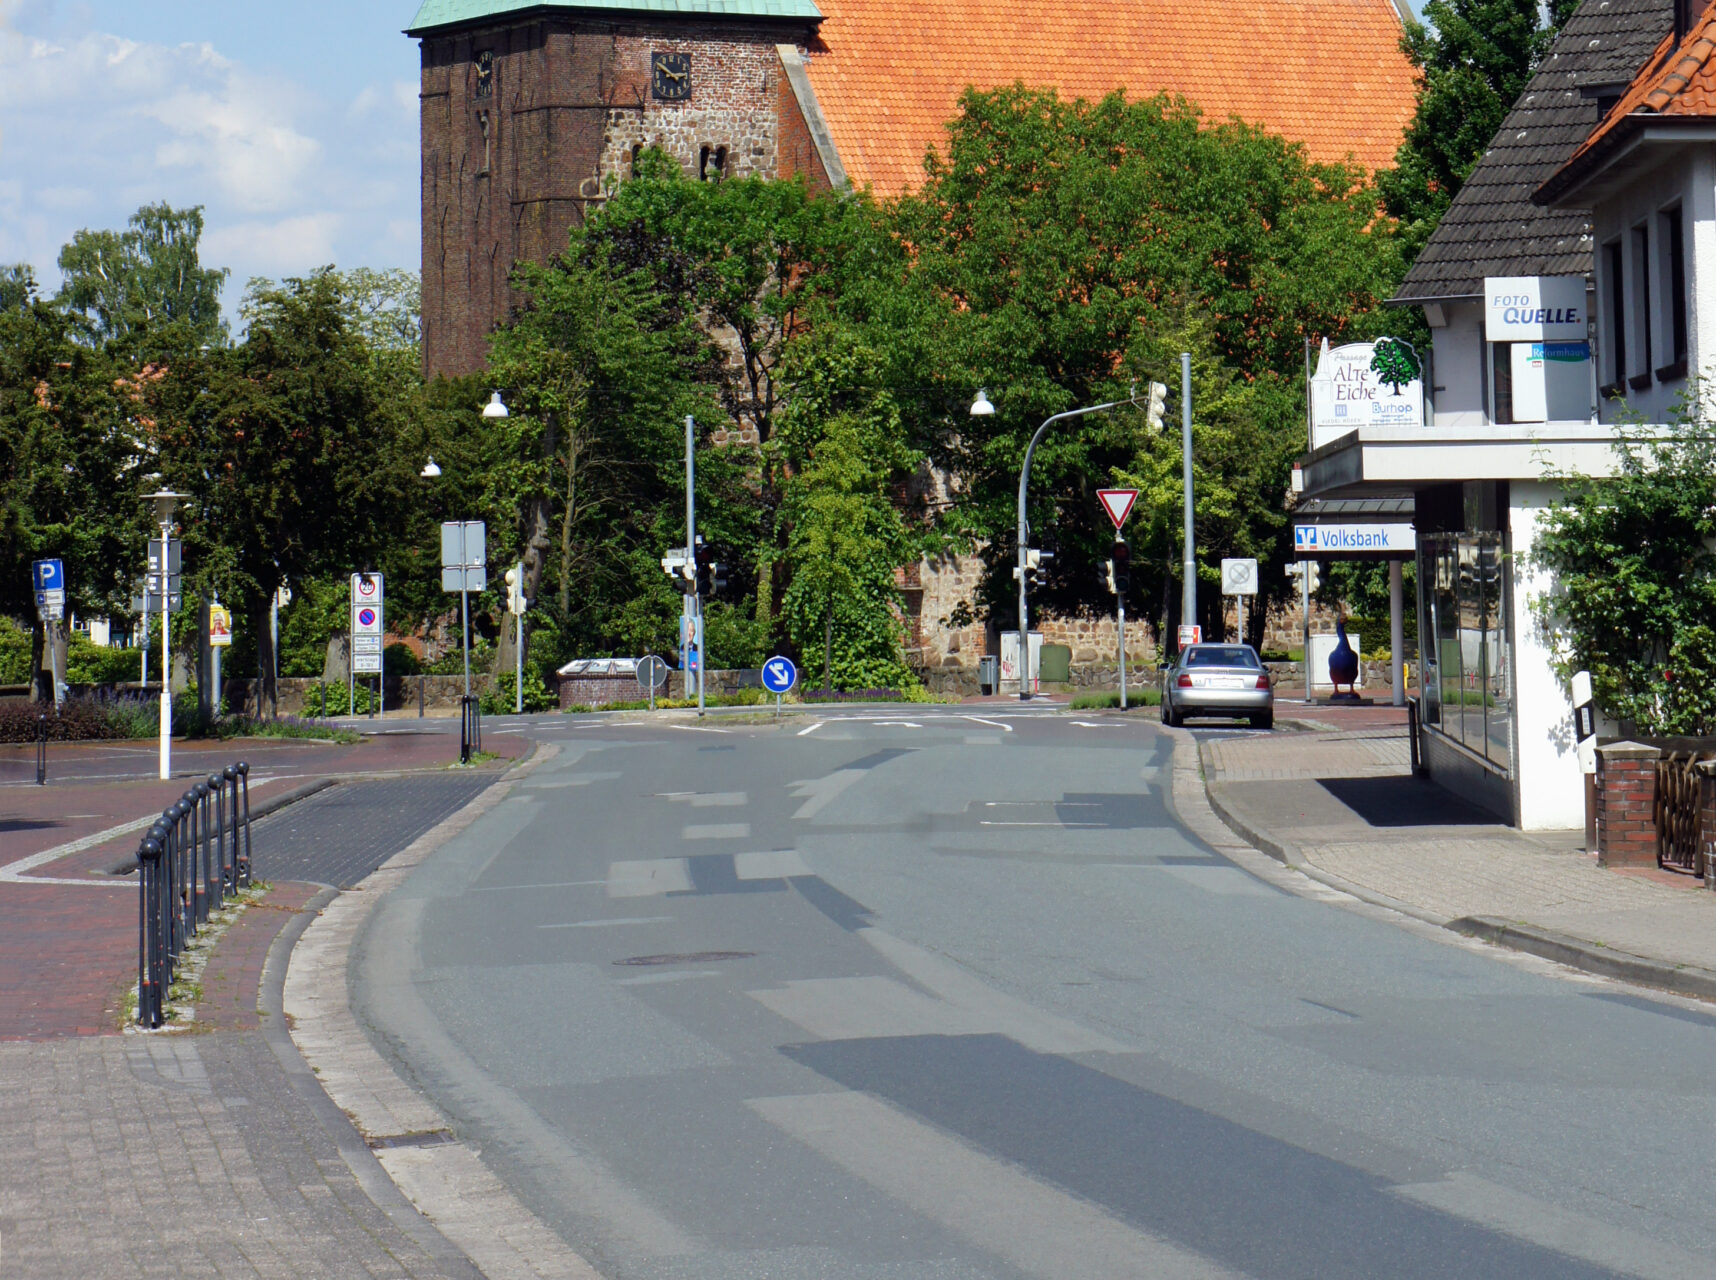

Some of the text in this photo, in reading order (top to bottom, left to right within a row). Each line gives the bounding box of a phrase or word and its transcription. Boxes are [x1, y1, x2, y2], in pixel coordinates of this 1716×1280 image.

[1493, 295, 1530, 306] FOTO
[1533, 347, 1585, 359] Reformhaus
[1336, 381, 1377, 401] Eiche
[1371, 401, 1413, 414] Burhop
[1321, 529, 1390, 547] Volksbank
[39, 563, 55, 587] P
